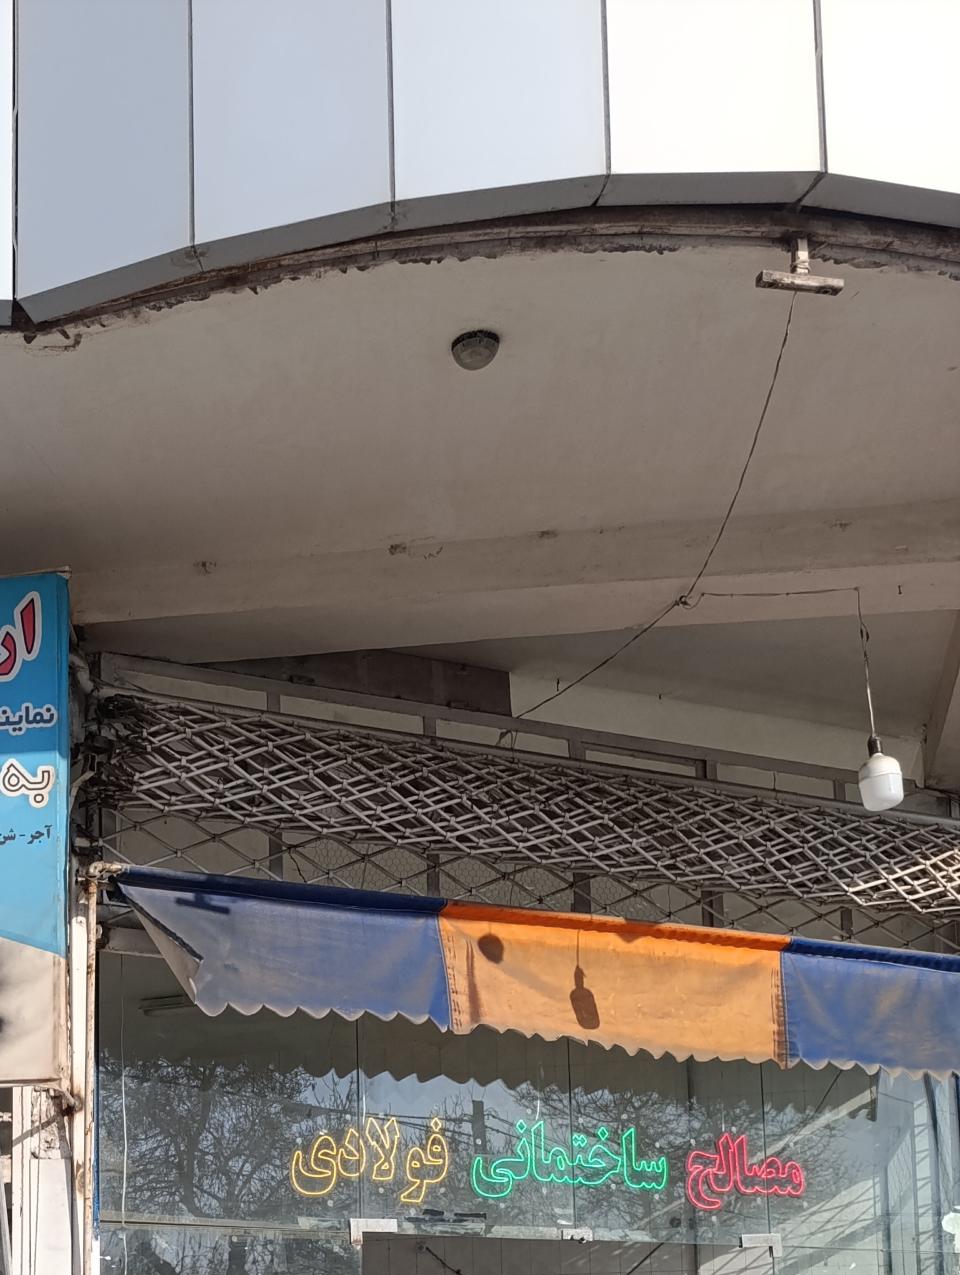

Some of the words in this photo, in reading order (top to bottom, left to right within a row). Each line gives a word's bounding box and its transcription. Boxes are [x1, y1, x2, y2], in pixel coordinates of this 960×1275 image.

[0, 760, 52, 805] به
[291, 1116, 449, 1203] فولادی
[471, 1119, 668, 1198] ساختمانی
[687, 1133, 805, 1210] مصالح
